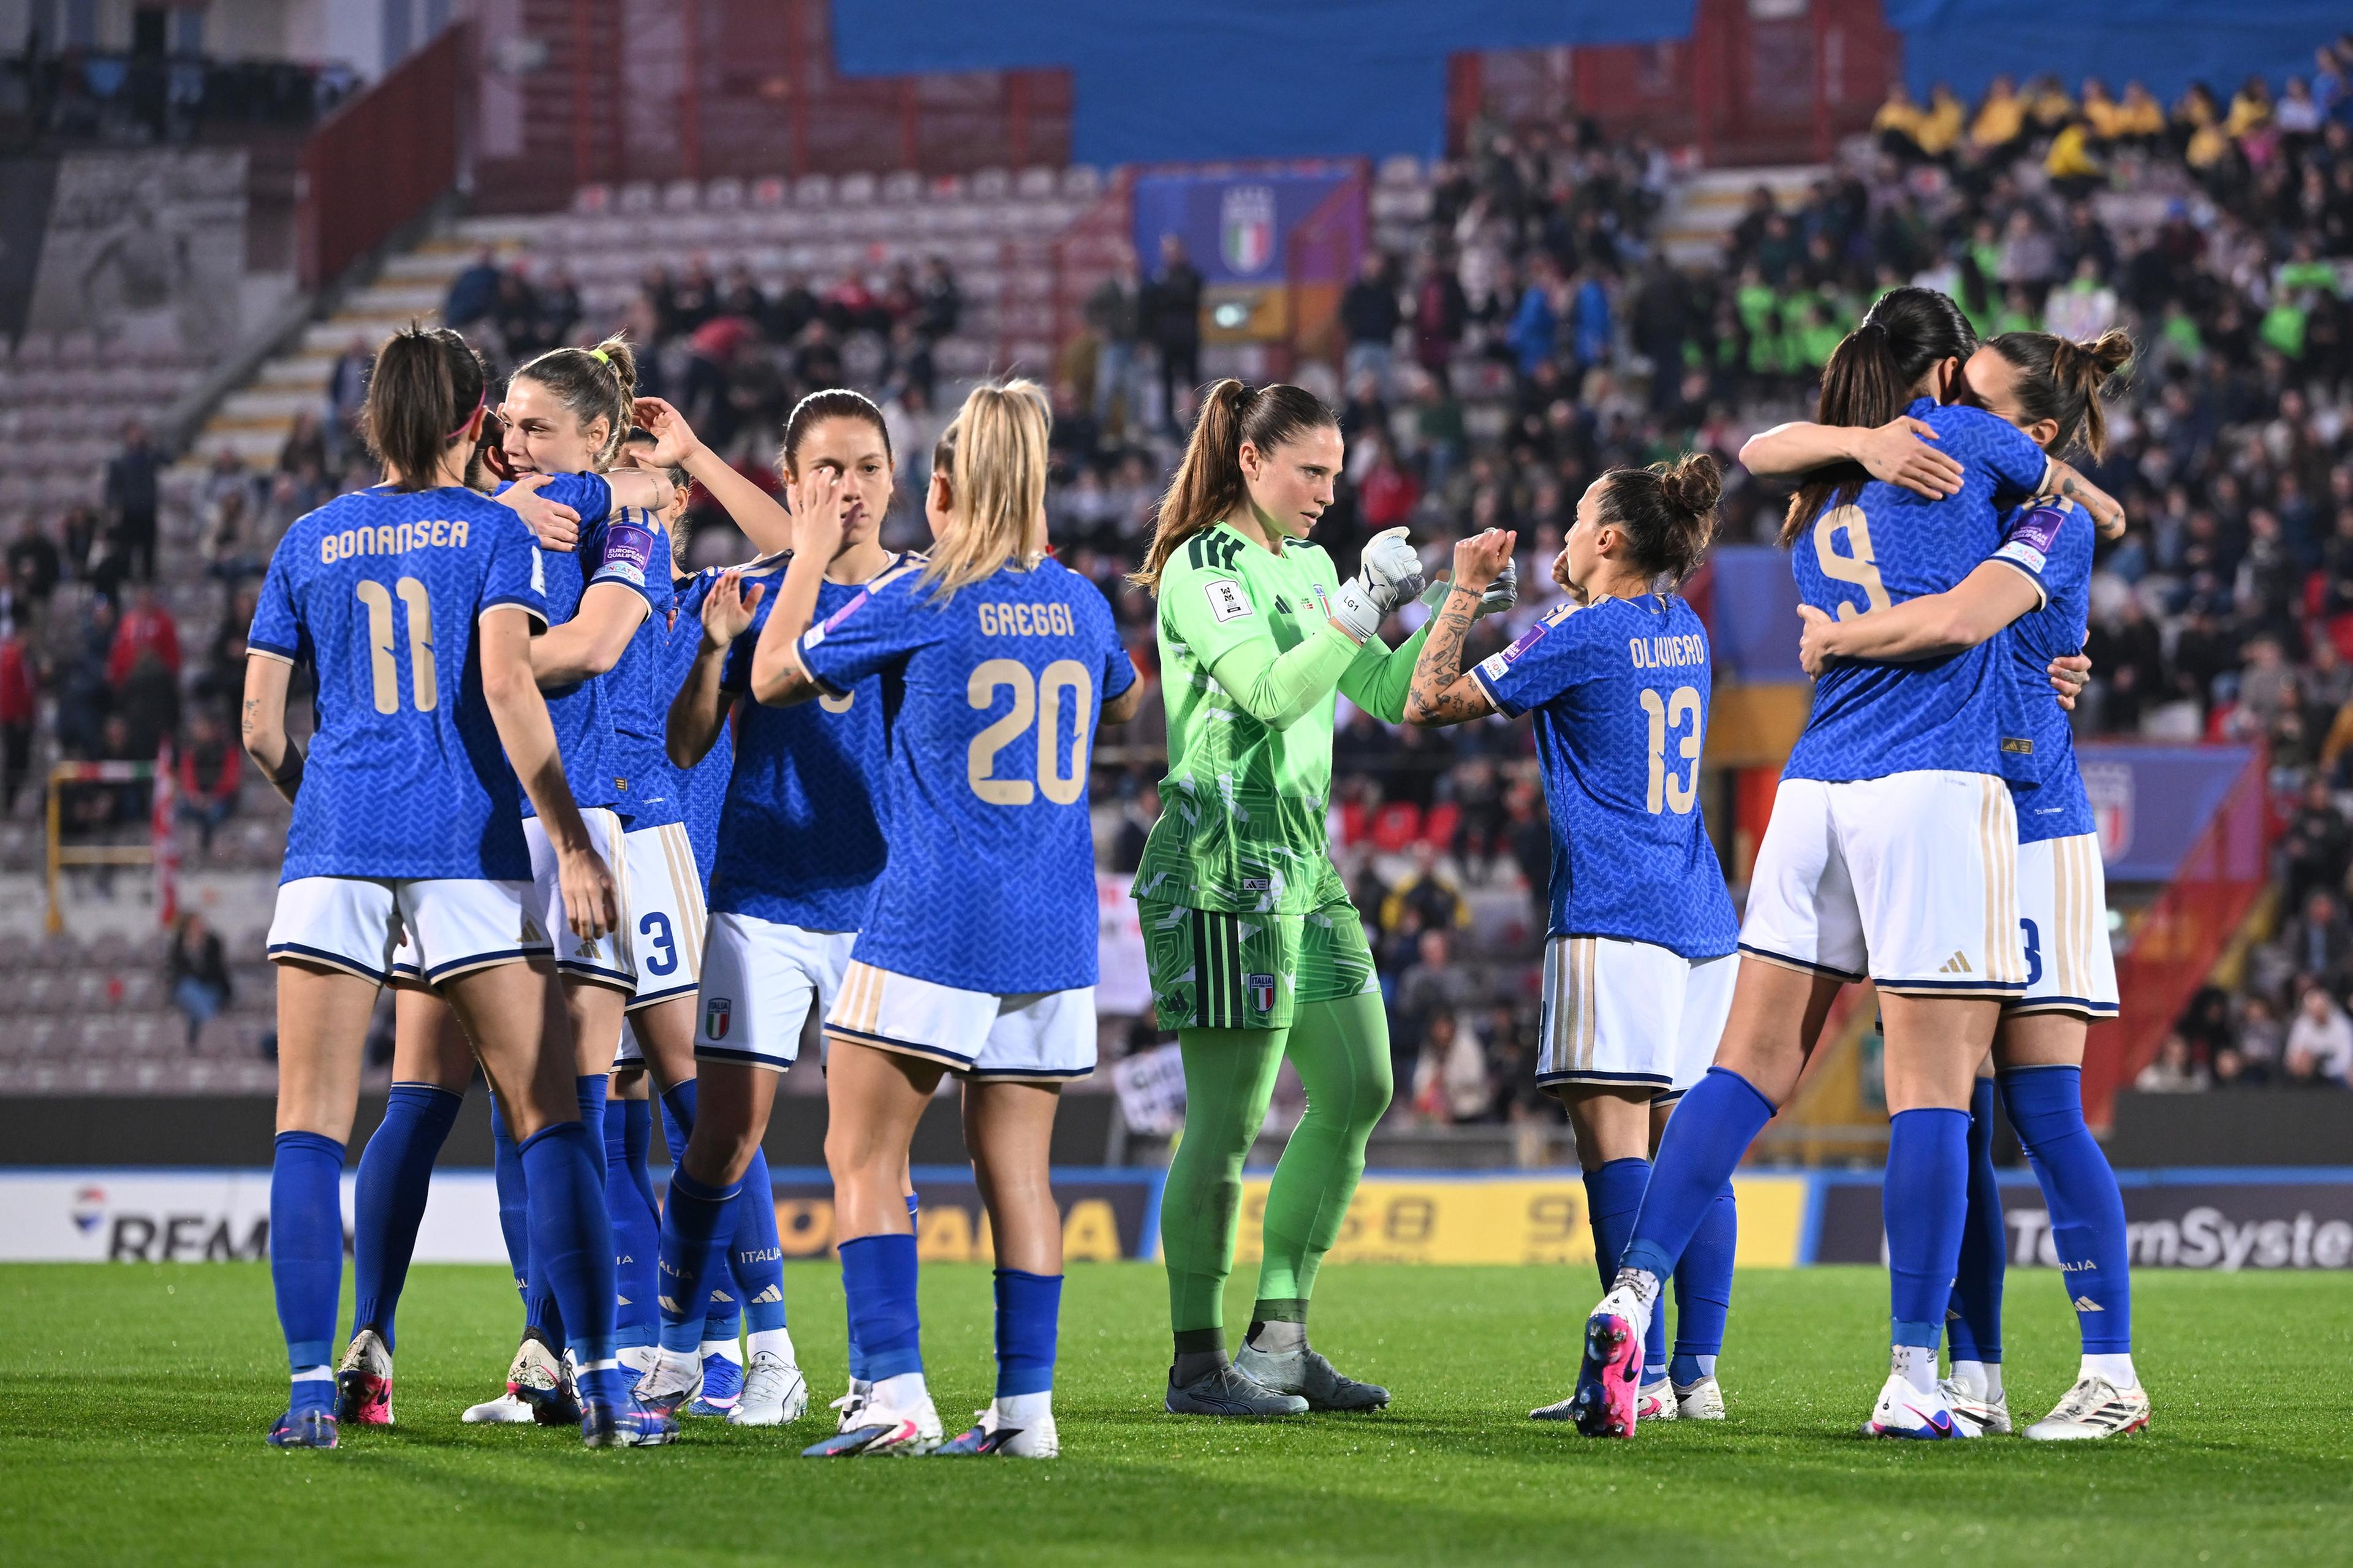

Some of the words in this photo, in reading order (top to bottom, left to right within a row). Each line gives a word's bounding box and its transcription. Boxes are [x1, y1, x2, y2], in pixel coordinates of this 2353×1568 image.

[321, 520, 469, 564] BONANSEA
[608, 548, 645, 561] EUROPEAN
[1813, 504, 1892, 623] 9
[979, 602, 1075, 637] GREGGI
[1343, 596, 1359, 612] LG1
[356, 576, 438, 715] 11
[1629, 634, 1704, 668] OLIVIERO
[968, 658, 1092, 806] 20
[1640, 686, 1701, 816] 13
[639, 911, 678, 976] 3
[741, 1246, 781, 1263] ITALIA
